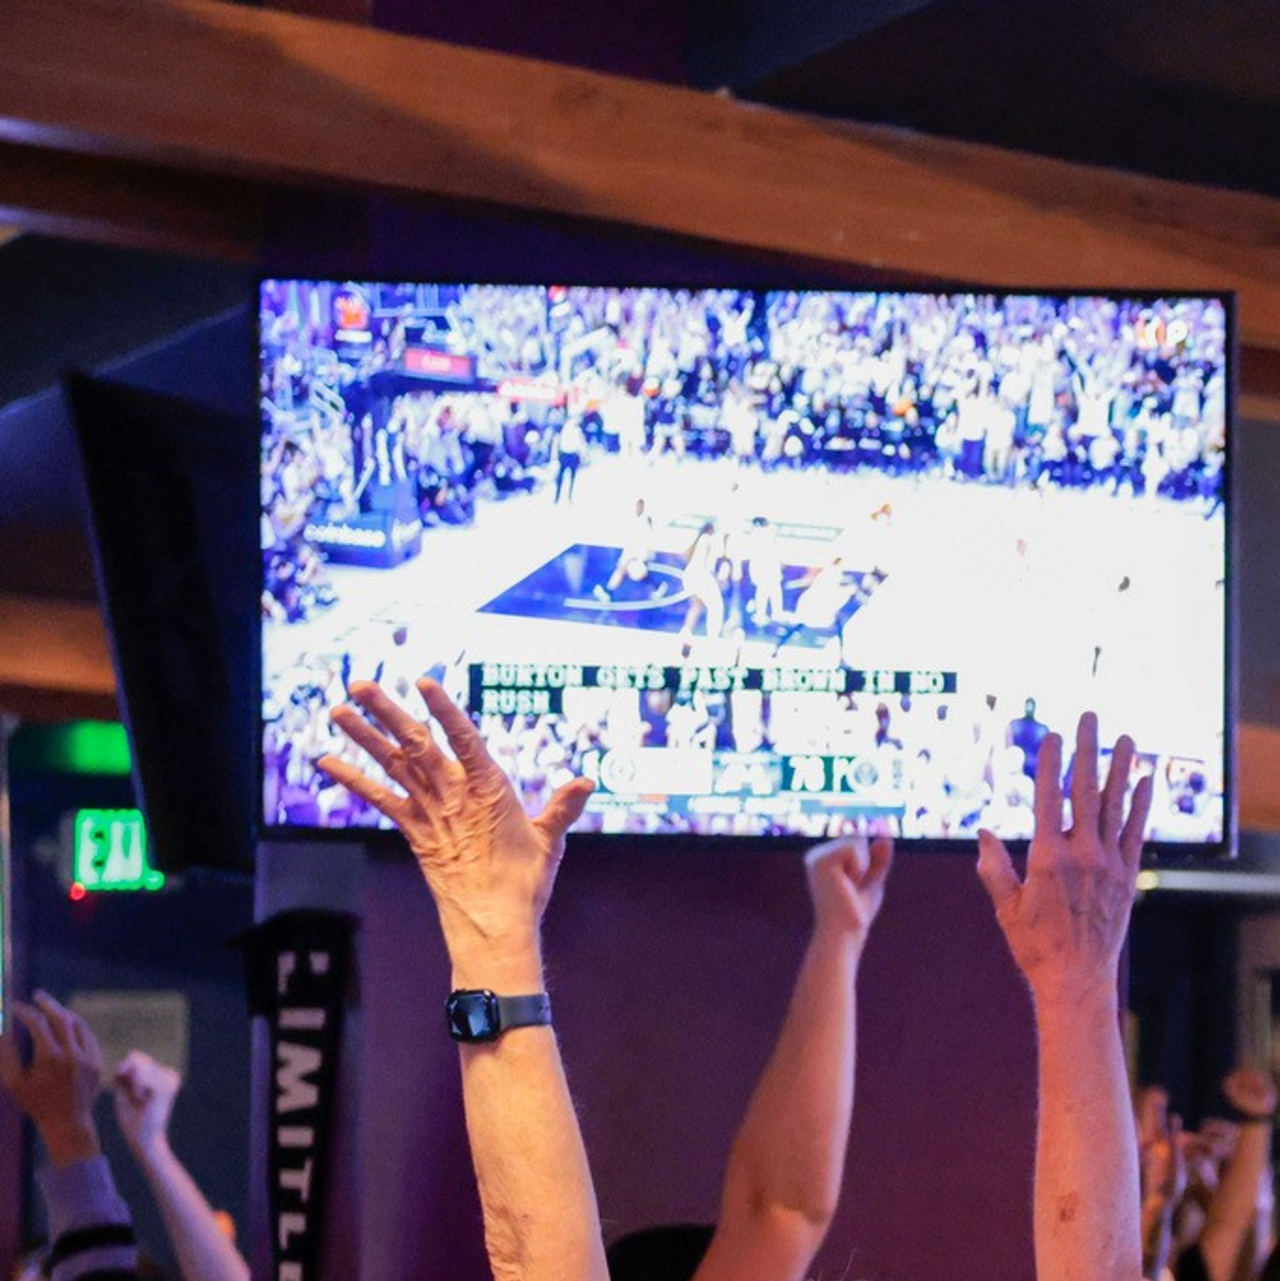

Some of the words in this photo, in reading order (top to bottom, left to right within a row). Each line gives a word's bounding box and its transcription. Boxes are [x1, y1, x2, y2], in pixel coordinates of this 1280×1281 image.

[482, 664, 583, 688] BURTON
[596, 665, 666, 689] GETS
[679, 666, 749, 690] PAST
[761, 668, 847, 692] BROWN
[861, 670, 896, 693] IN
[908, 671, 945, 693] NO
[481, 689, 549, 715] RUSH
